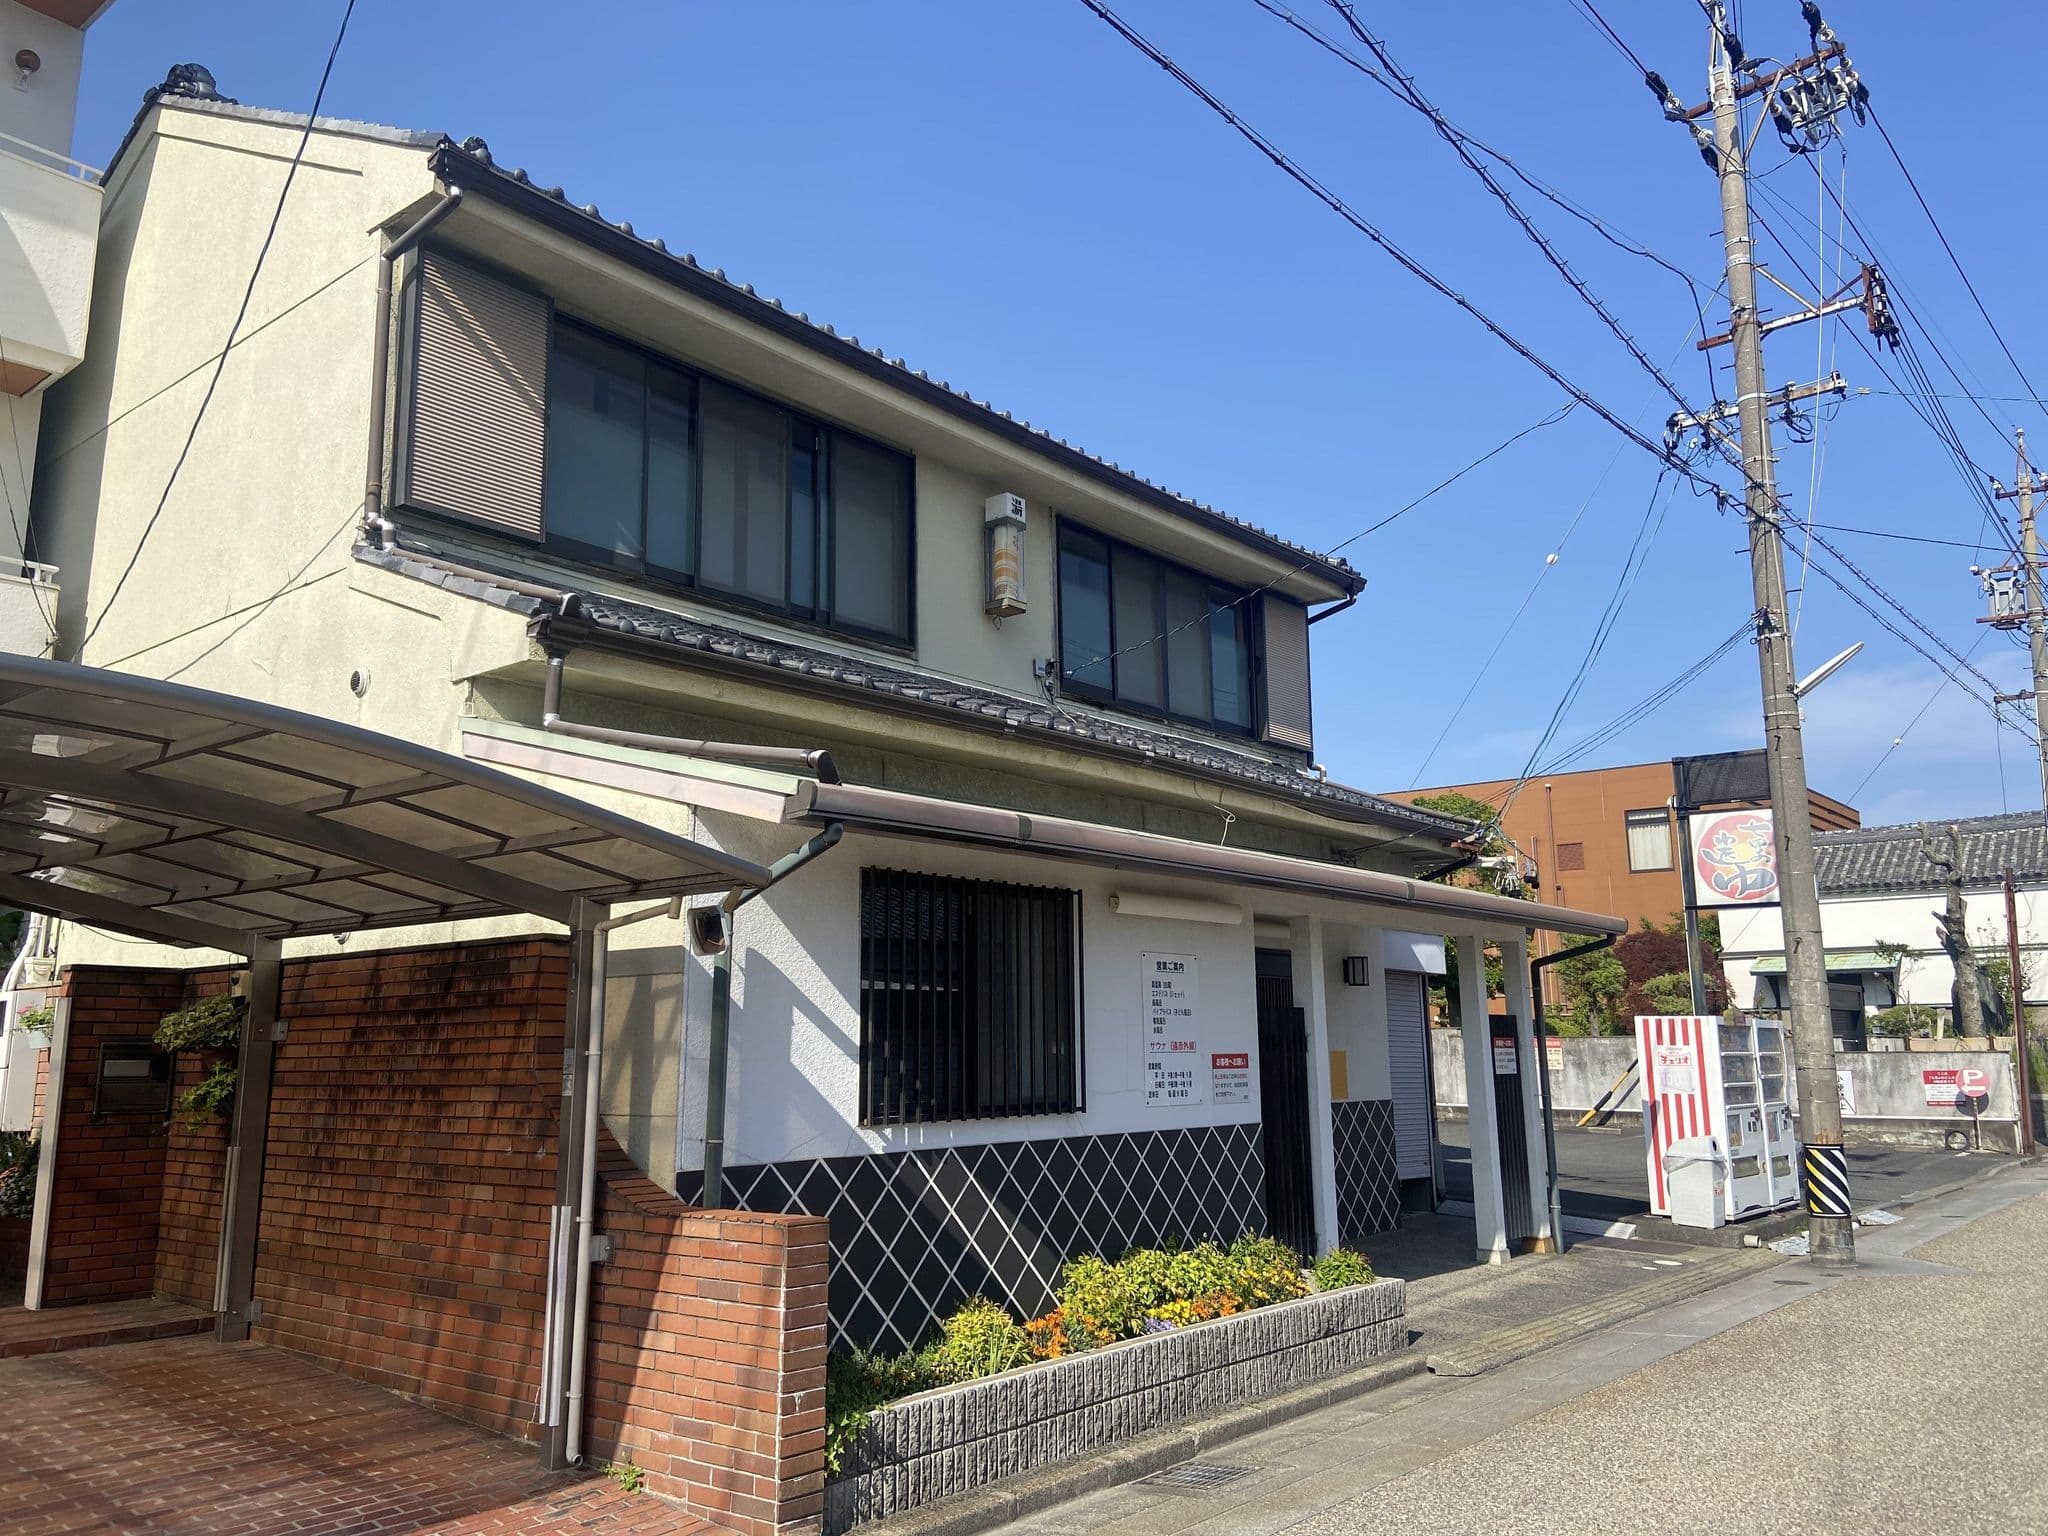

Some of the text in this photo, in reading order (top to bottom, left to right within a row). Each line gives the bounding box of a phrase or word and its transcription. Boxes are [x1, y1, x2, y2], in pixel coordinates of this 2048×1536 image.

[1150, 1041, 1166, 1050] サウナ
[1660, 1055, 1689, 1064] チェリオ
[1963, 1069, 1984, 1084] P
